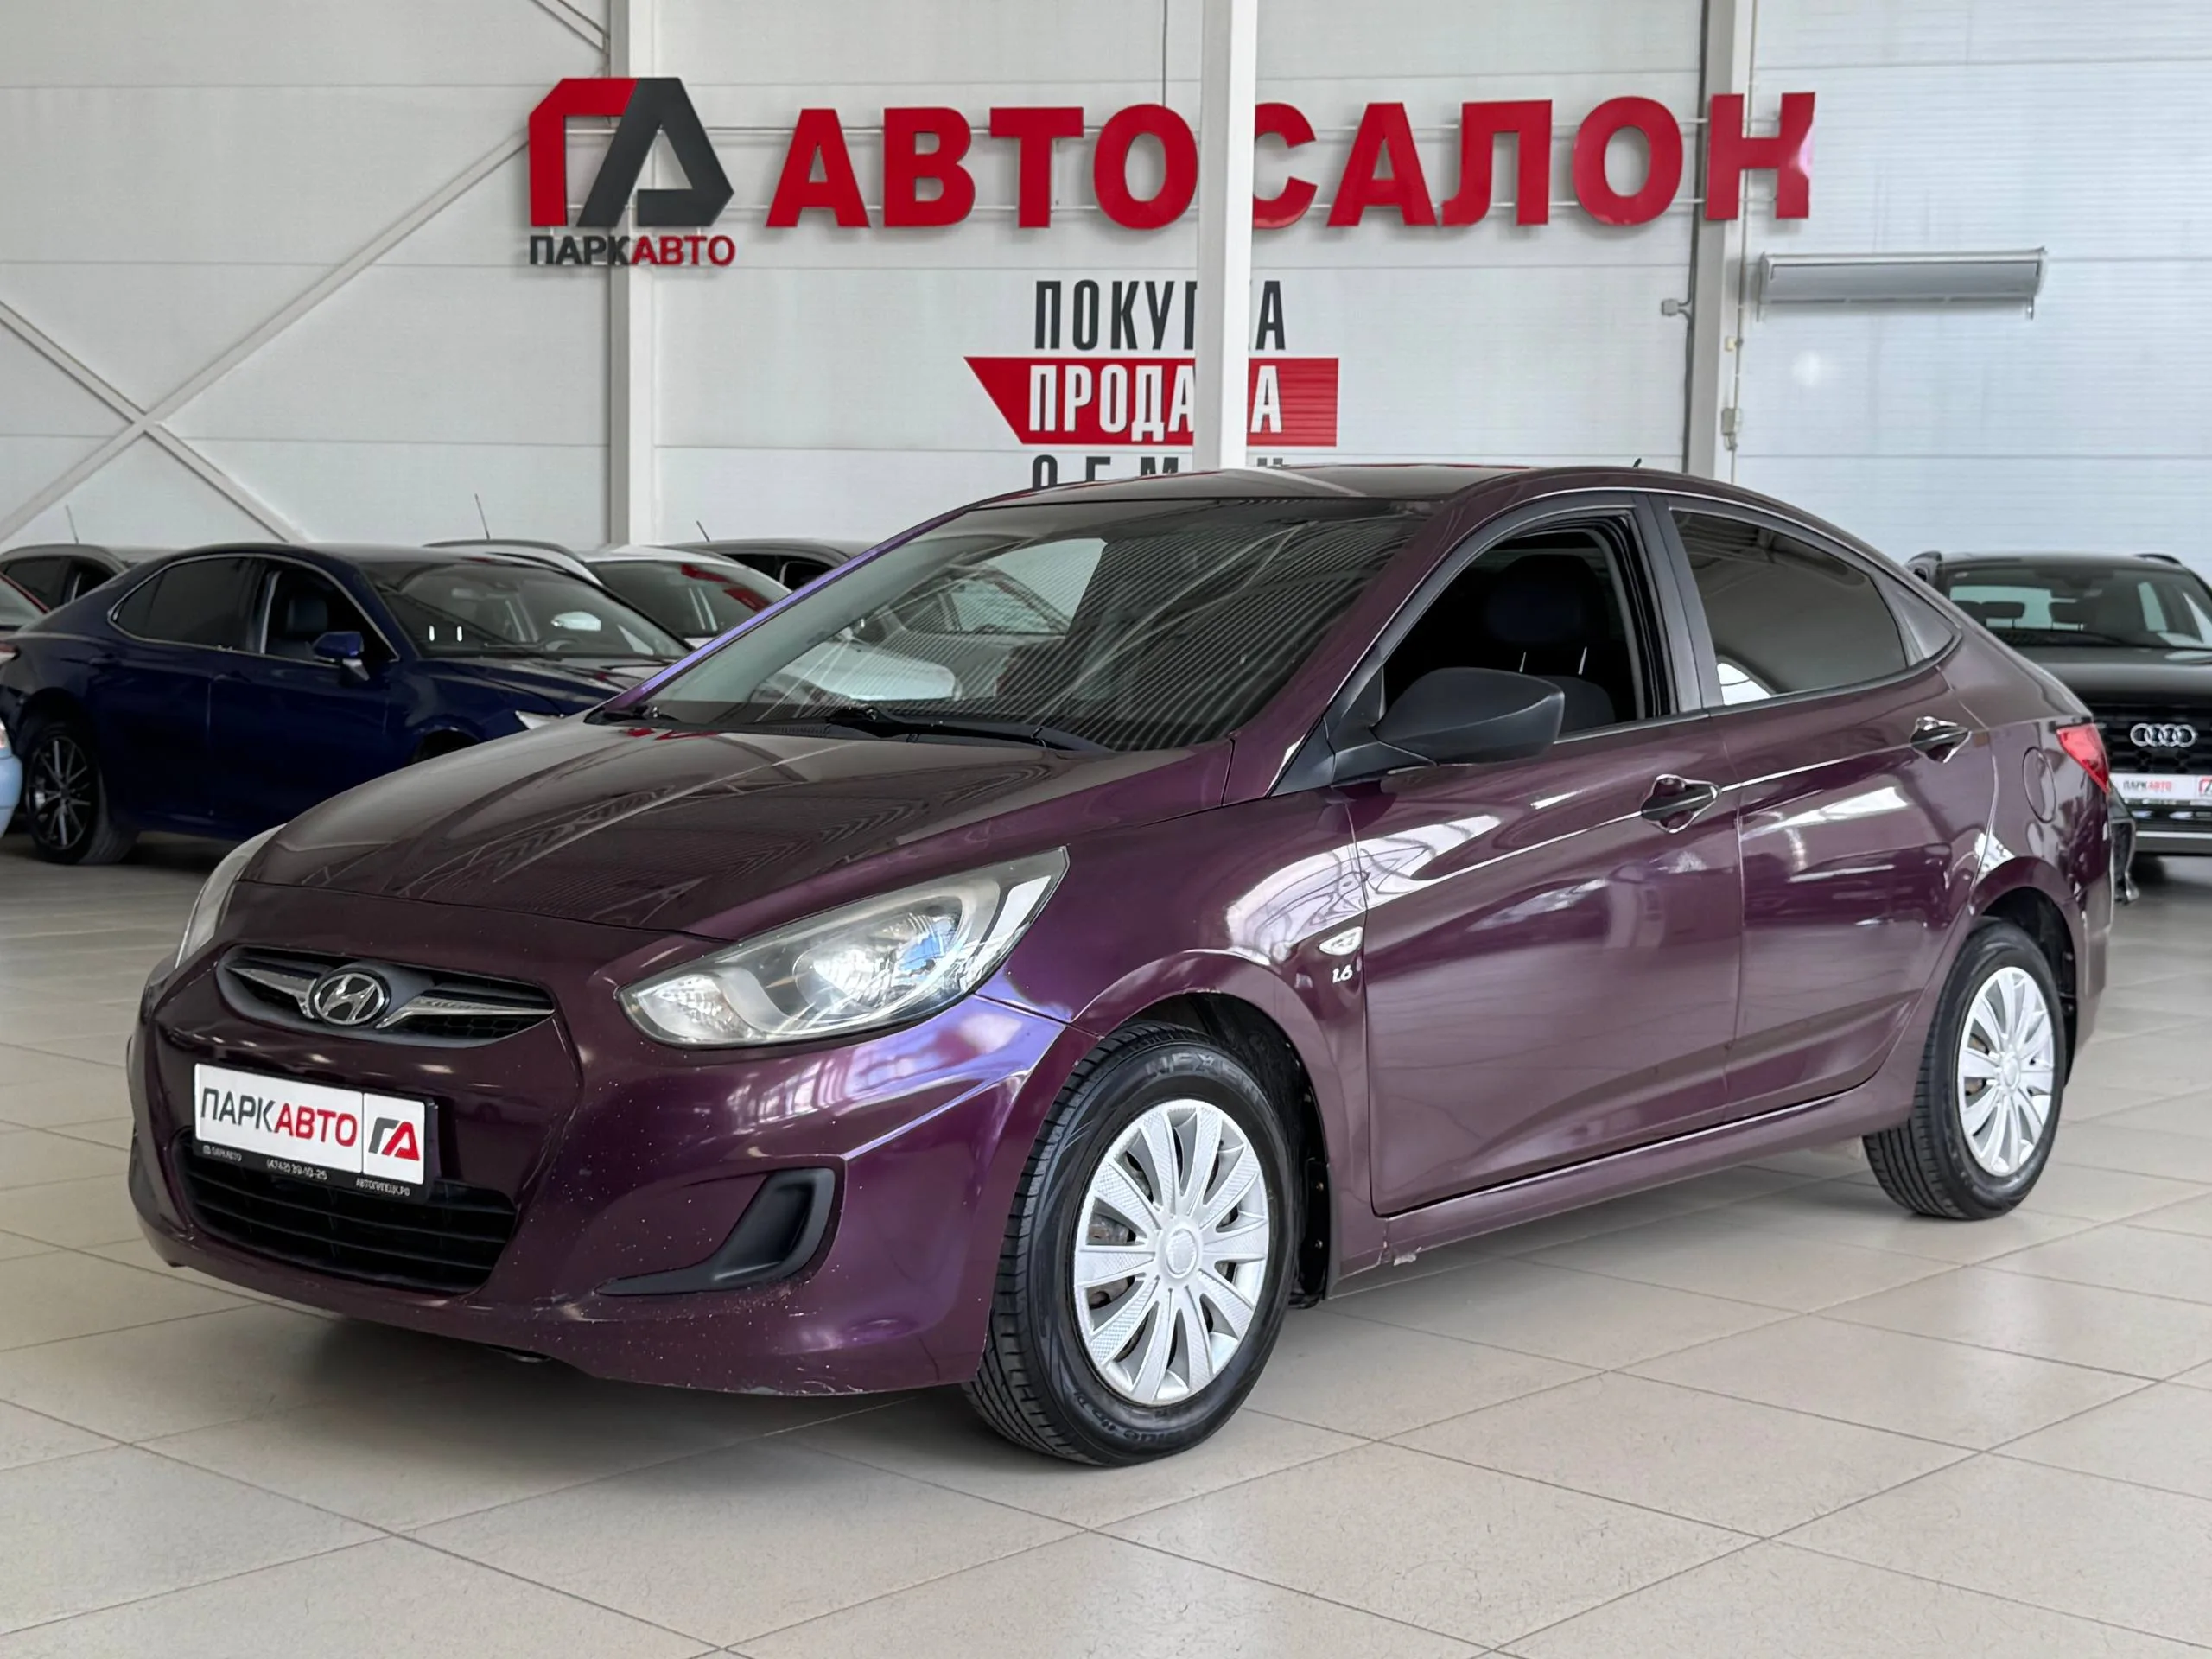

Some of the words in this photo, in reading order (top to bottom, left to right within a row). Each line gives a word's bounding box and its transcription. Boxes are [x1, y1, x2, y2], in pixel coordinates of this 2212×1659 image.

[530, 235, 736, 266] ПАРКАВТО
[1034, 279, 1286, 351] ПОКУА
[1029, 364, 1282, 442] ПРОДАА
[1332, 963, 1353, 983] 1.6
[200, 1087, 358, 1147] ПАРКАВТО
